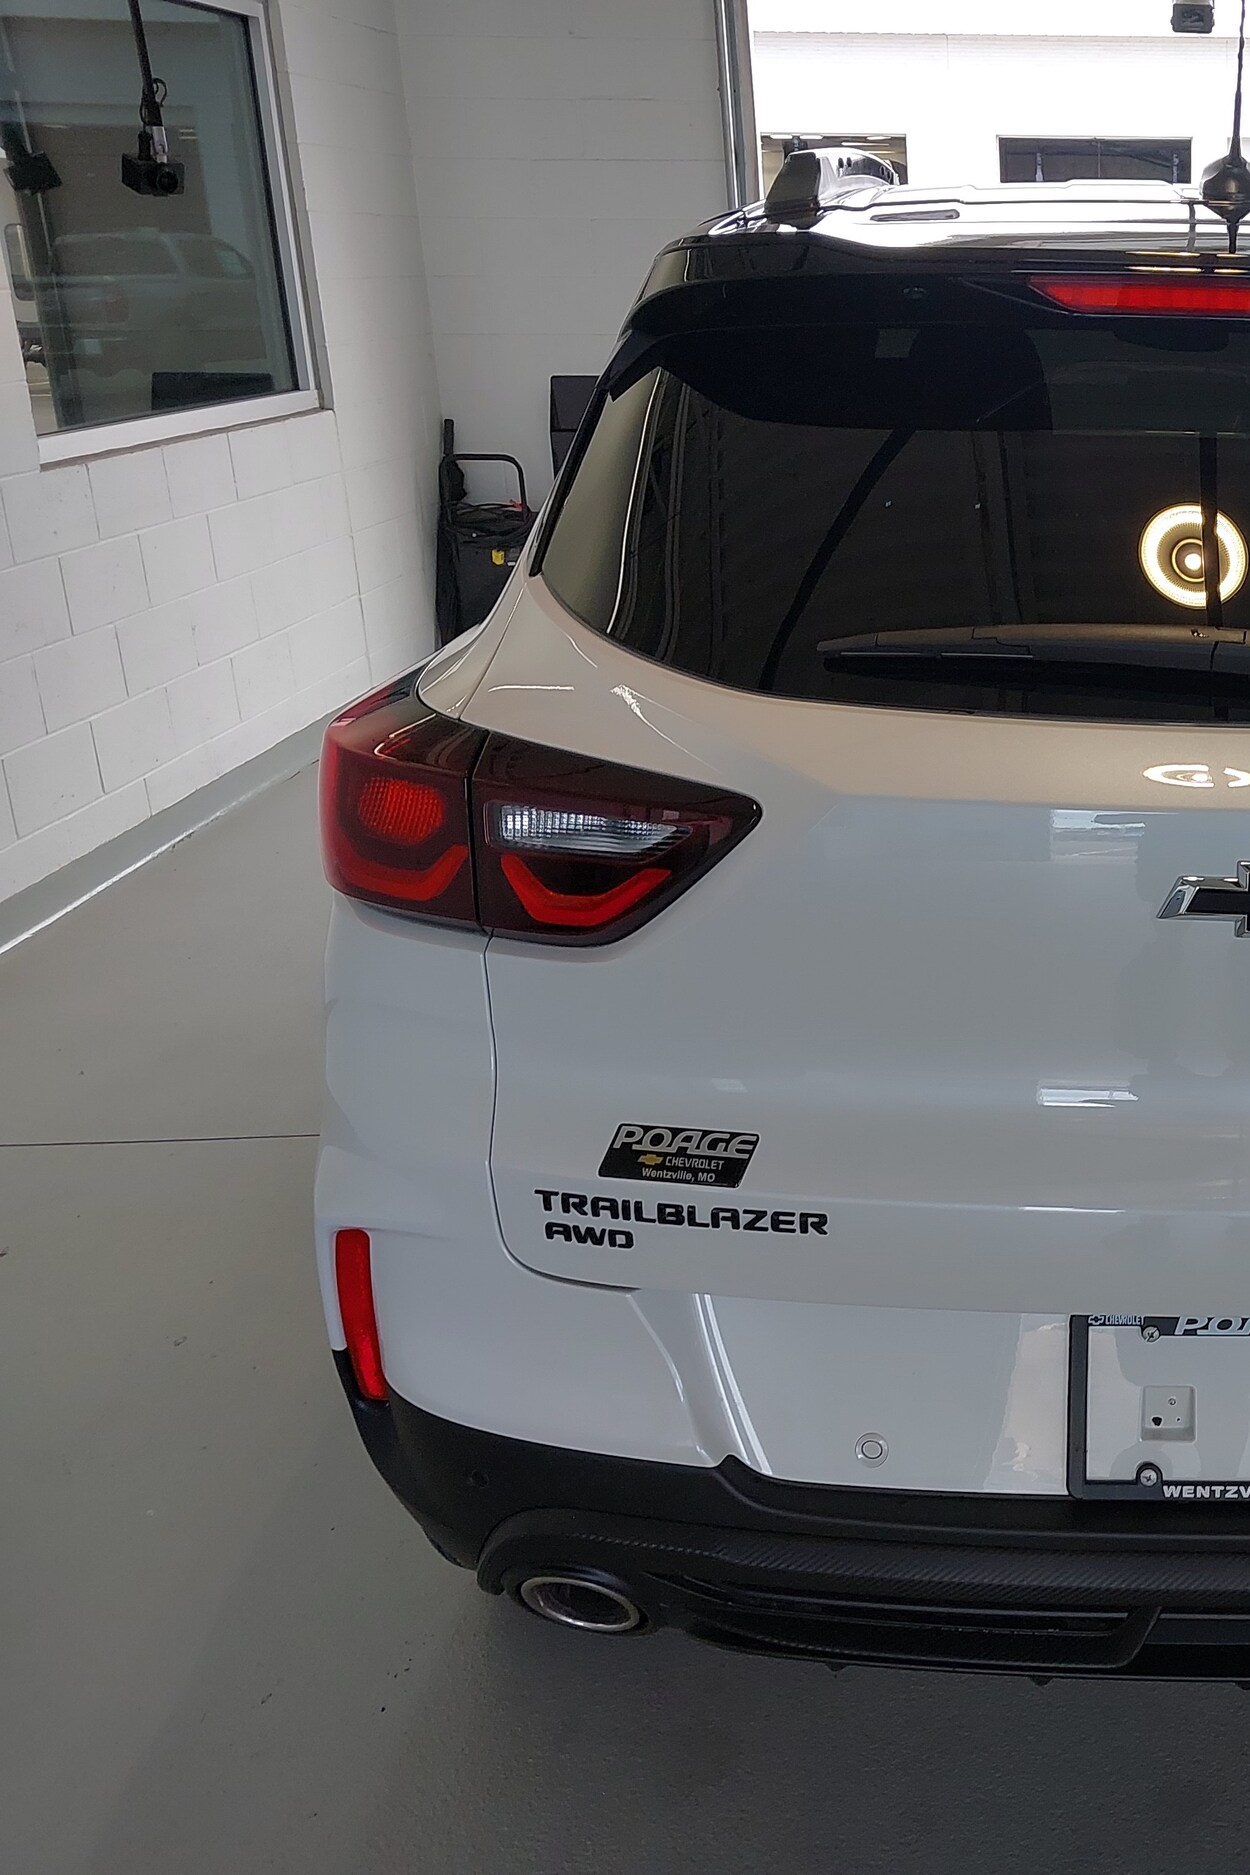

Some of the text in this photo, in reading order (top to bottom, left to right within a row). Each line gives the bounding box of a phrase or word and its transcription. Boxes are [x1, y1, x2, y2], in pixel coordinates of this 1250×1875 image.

[612, 1125, 758, 1159] POAGE
[665, 1156, 724, 1170] CHEVROLET
[641, 1167, 716, 1182] Wentzville, MO
[534, 1189, 829, 1235] TRAILBLAZER
[545, 1221, 634, 1248] AWD
[1105, 1315, 1145, 1326] CHEVROLET
